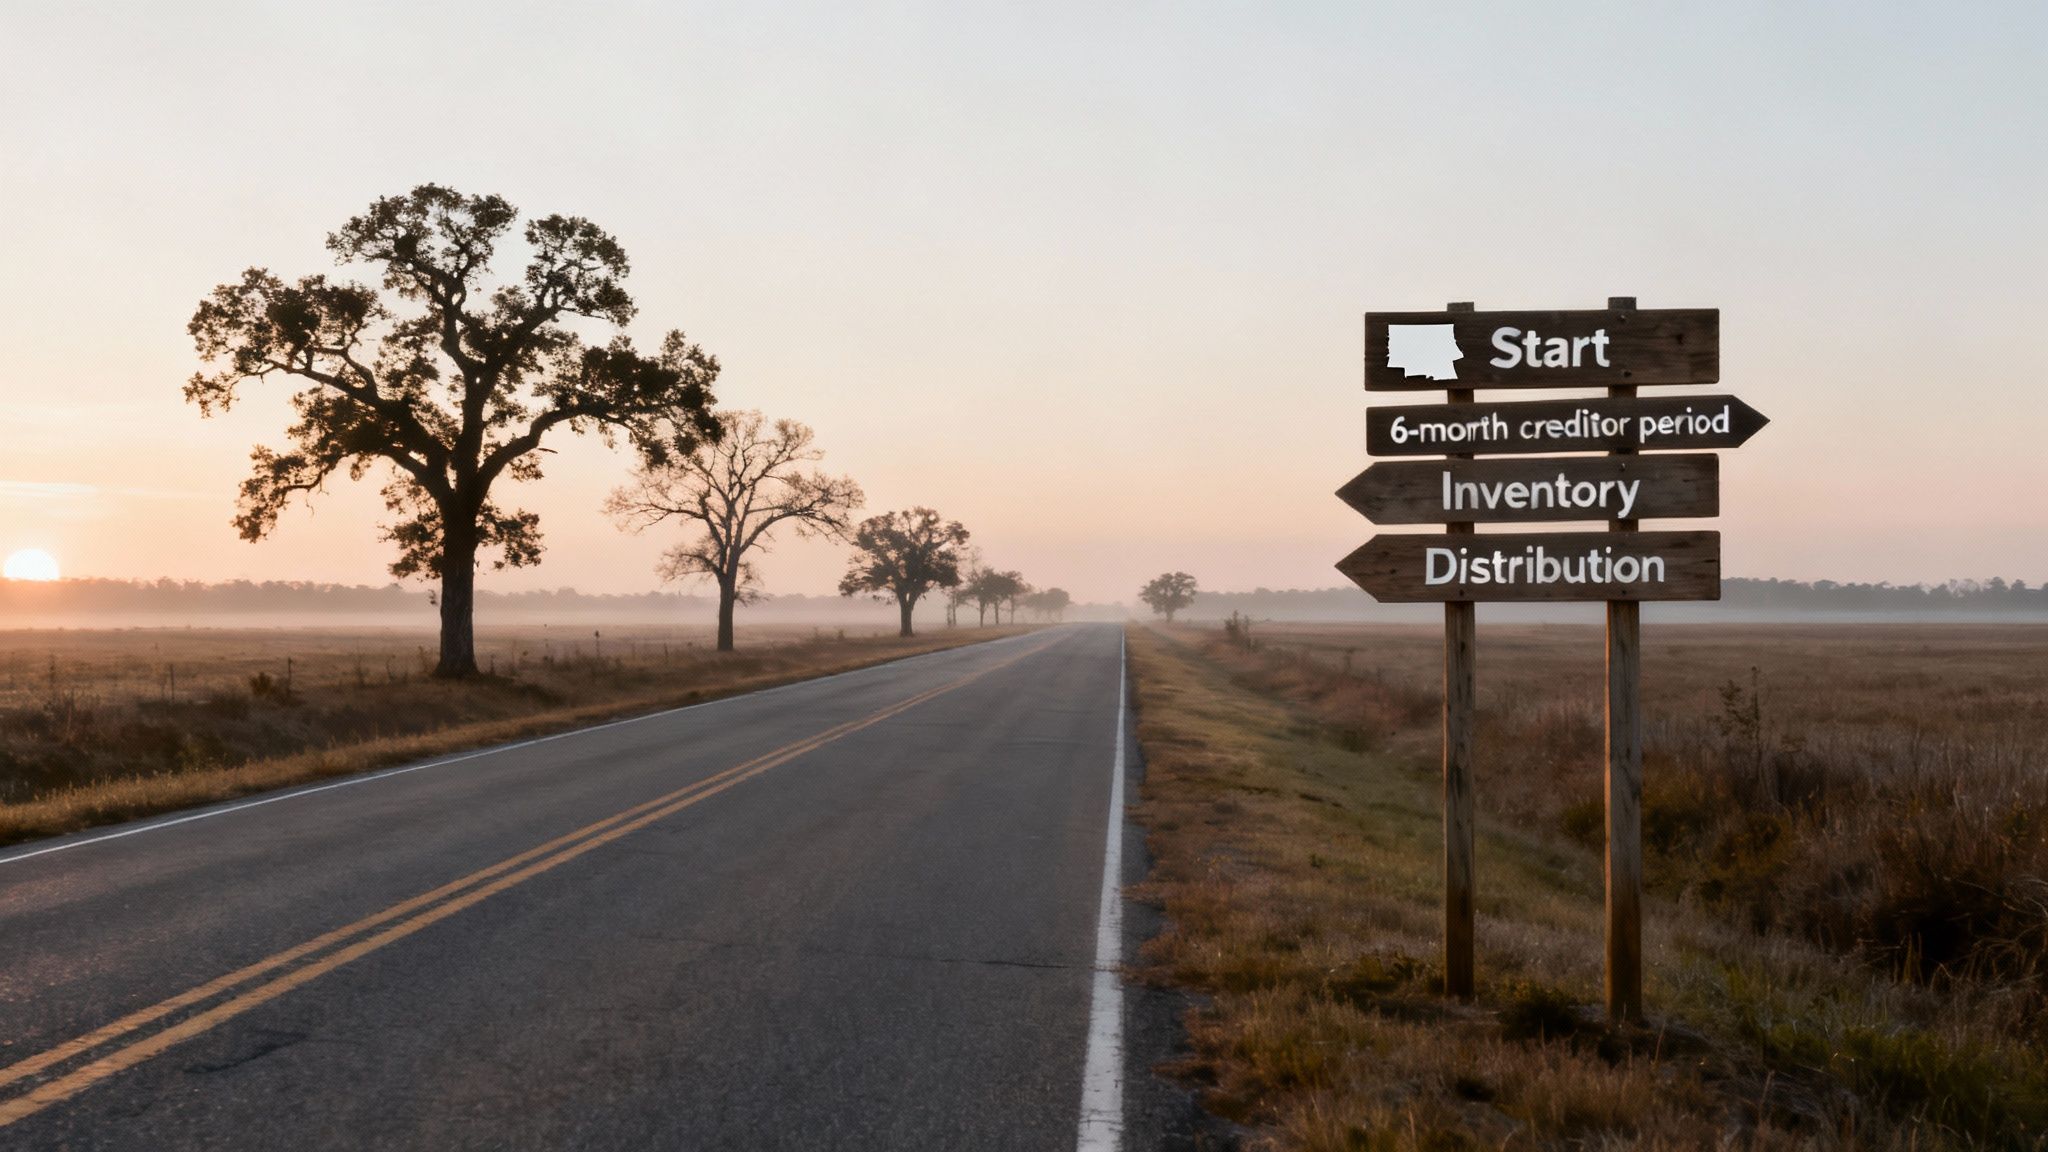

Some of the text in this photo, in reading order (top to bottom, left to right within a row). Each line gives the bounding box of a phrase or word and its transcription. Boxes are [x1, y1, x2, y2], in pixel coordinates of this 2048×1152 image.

[1489, 326, 1610, 369] Start
[1639, 404, 1730, 444] period
[1442, 471, 1640, 519] Inventory
[1424, 545, 1666, 585] Distribution
